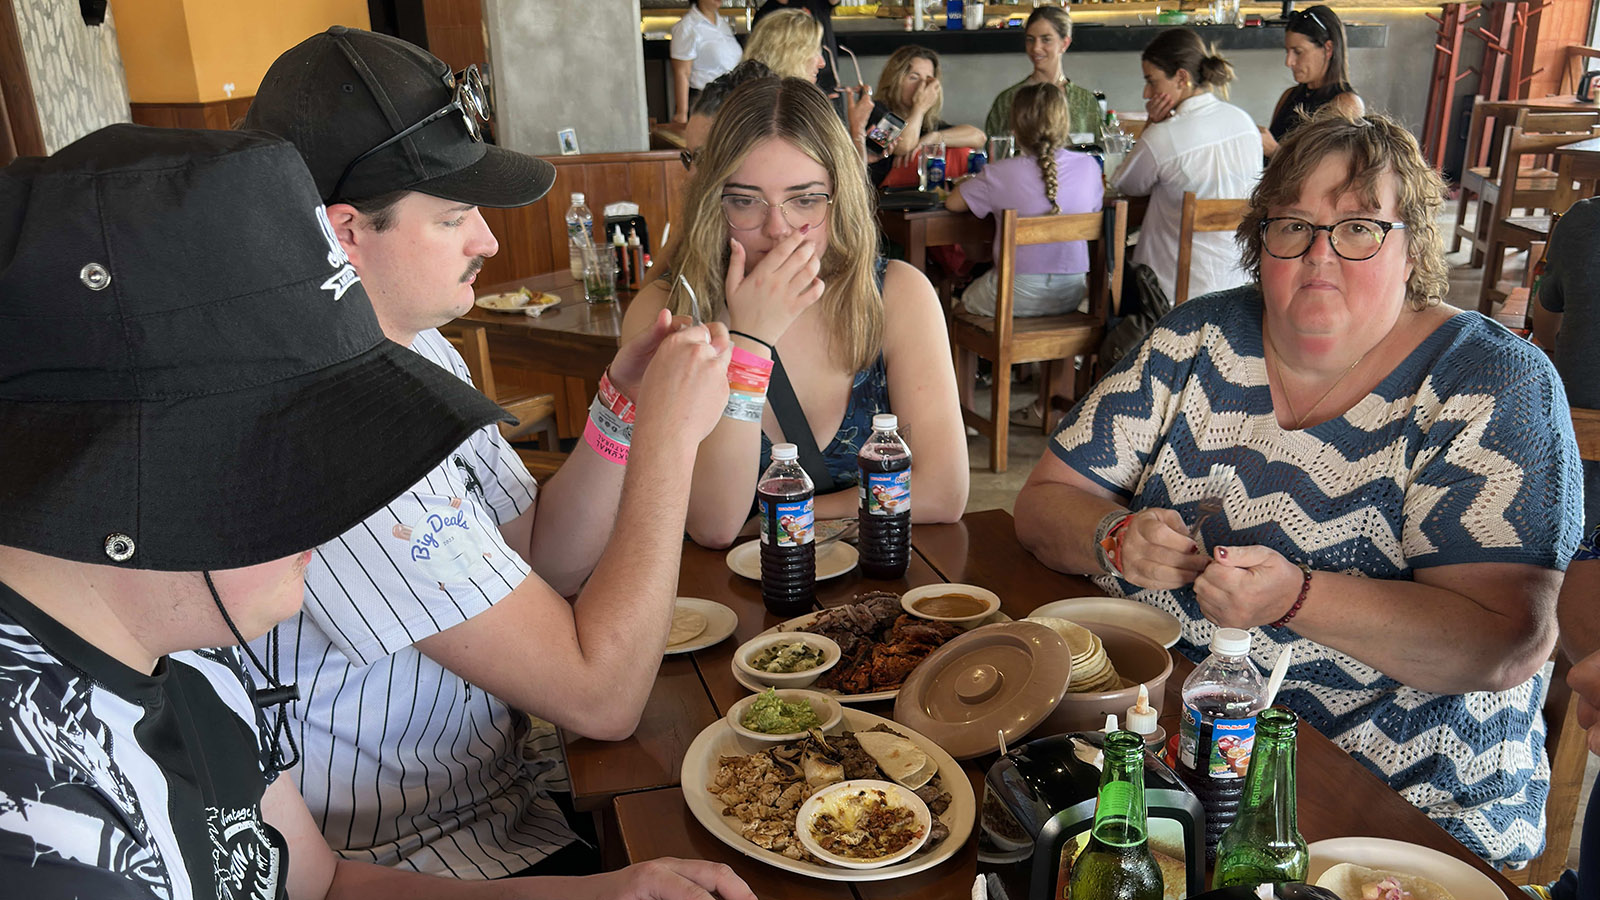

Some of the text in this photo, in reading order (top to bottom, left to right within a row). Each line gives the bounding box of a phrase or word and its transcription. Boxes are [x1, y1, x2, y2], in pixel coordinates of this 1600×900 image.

[411, 510, 470, 562] Big Deals
[220, 807, 252, 827] Vintage
